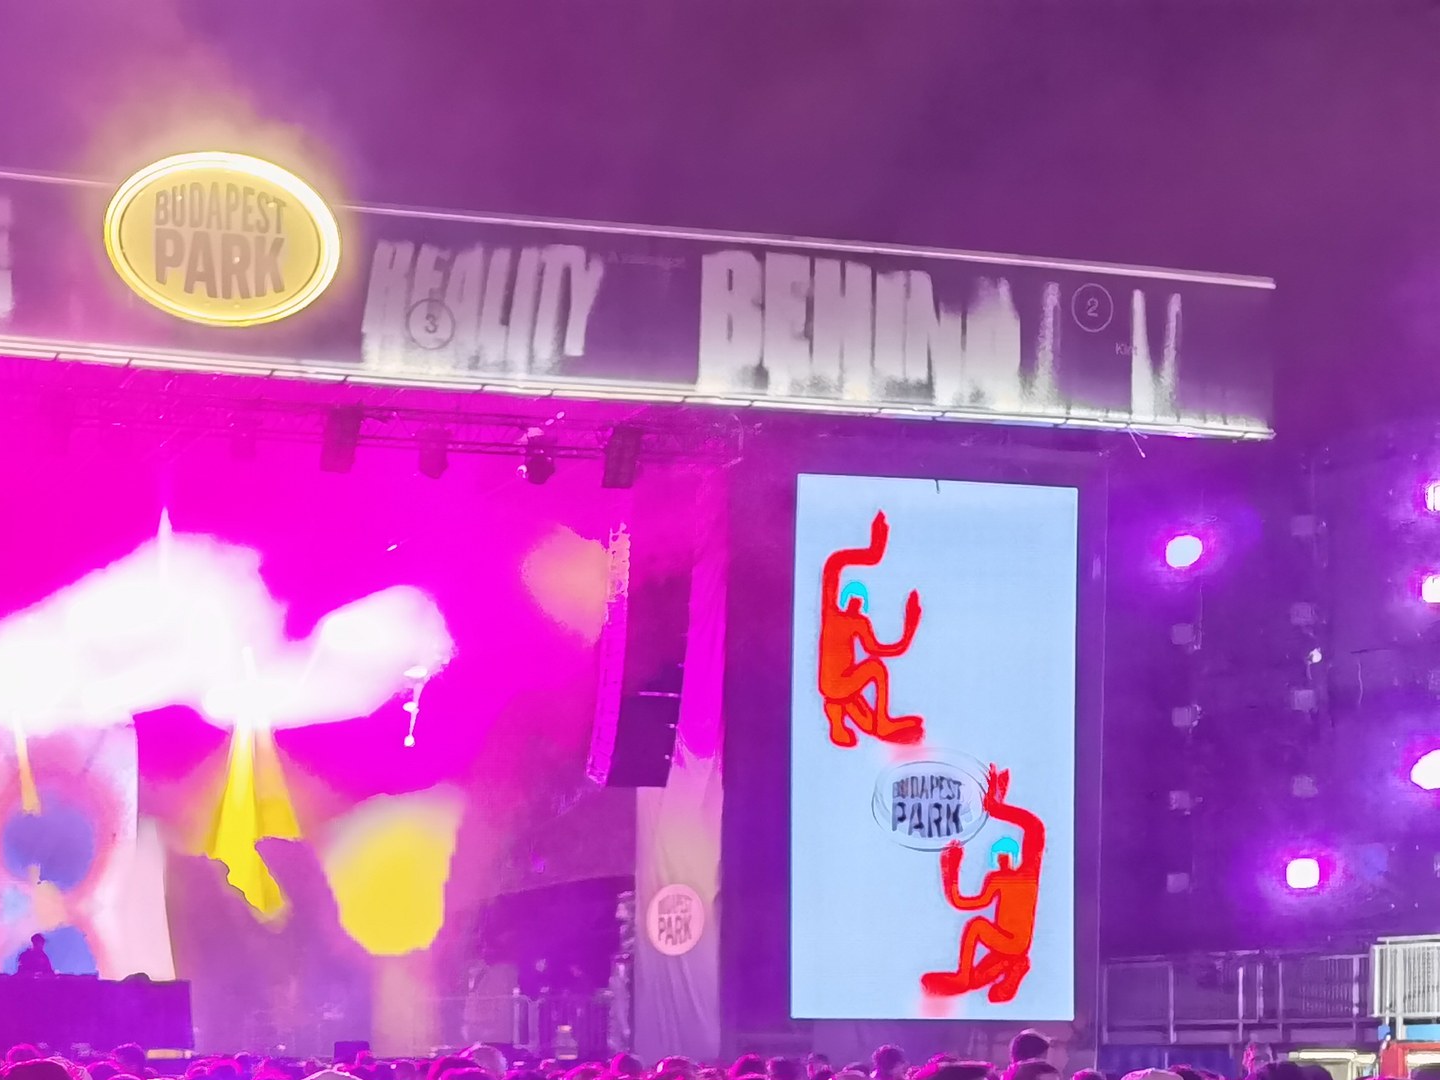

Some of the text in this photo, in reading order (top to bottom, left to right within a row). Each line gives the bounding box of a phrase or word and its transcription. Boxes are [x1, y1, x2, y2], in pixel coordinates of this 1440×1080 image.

[154, 181, 287, 234] BUDAPEST
[154, 227, 286, 300] PARK
[891, 774, 962, 800] BUDAPEST
[891, 801, 964, 838] PARK
[658, 914, 693, 946] PARK
